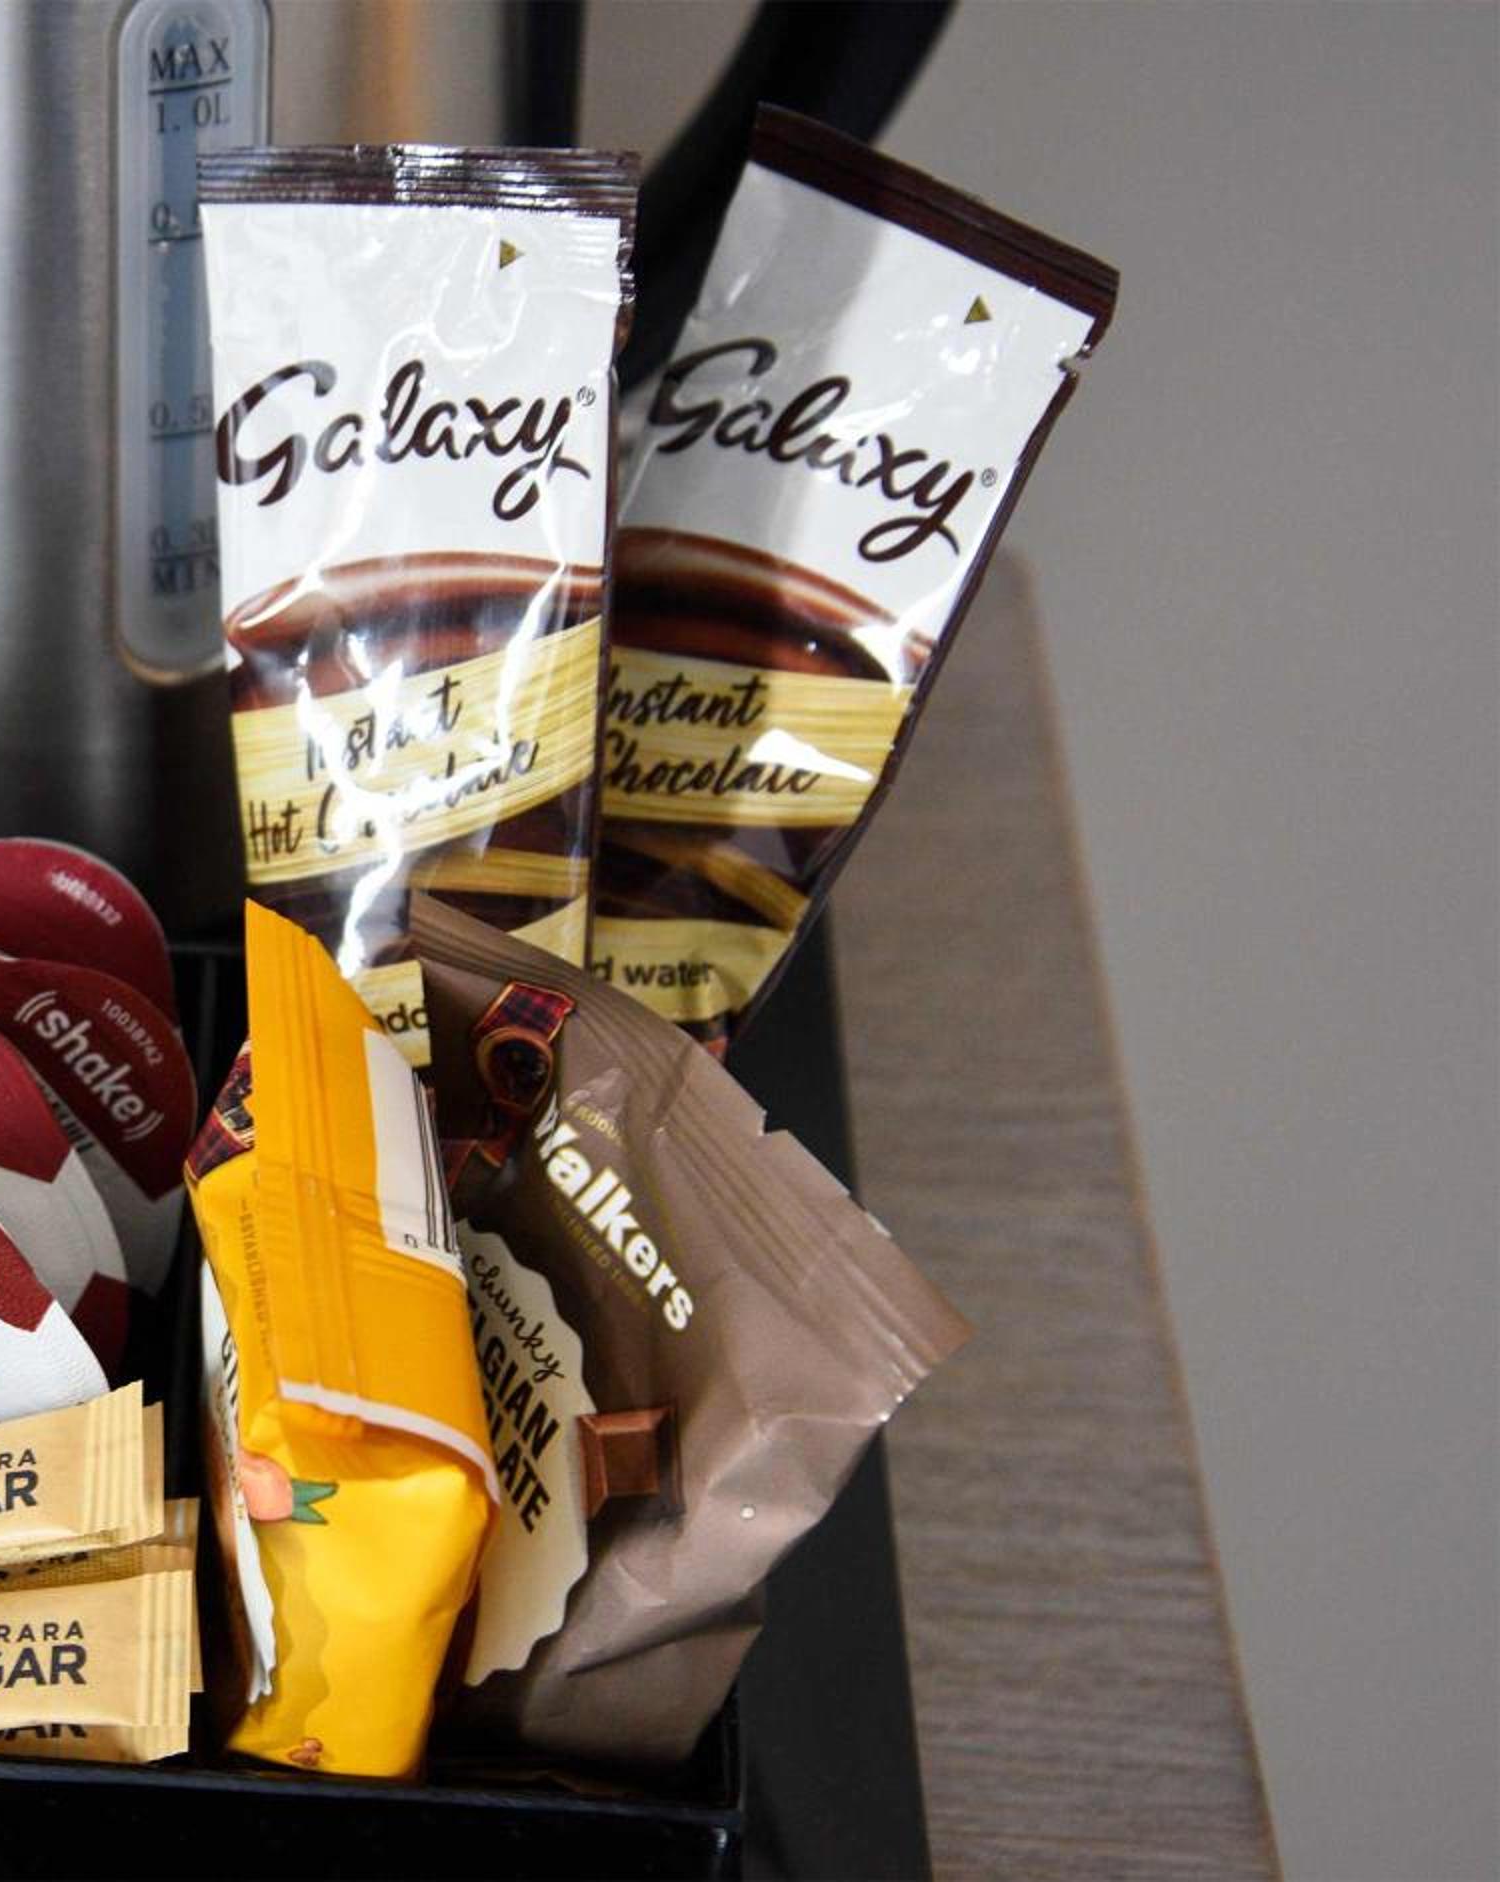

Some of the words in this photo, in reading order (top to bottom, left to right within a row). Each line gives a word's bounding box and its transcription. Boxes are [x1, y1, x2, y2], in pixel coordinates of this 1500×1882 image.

[149, 37, 230, 81] MAX
[248, 799, 303, 865] Hot
[471, 1254, 565, 1384] chunky
